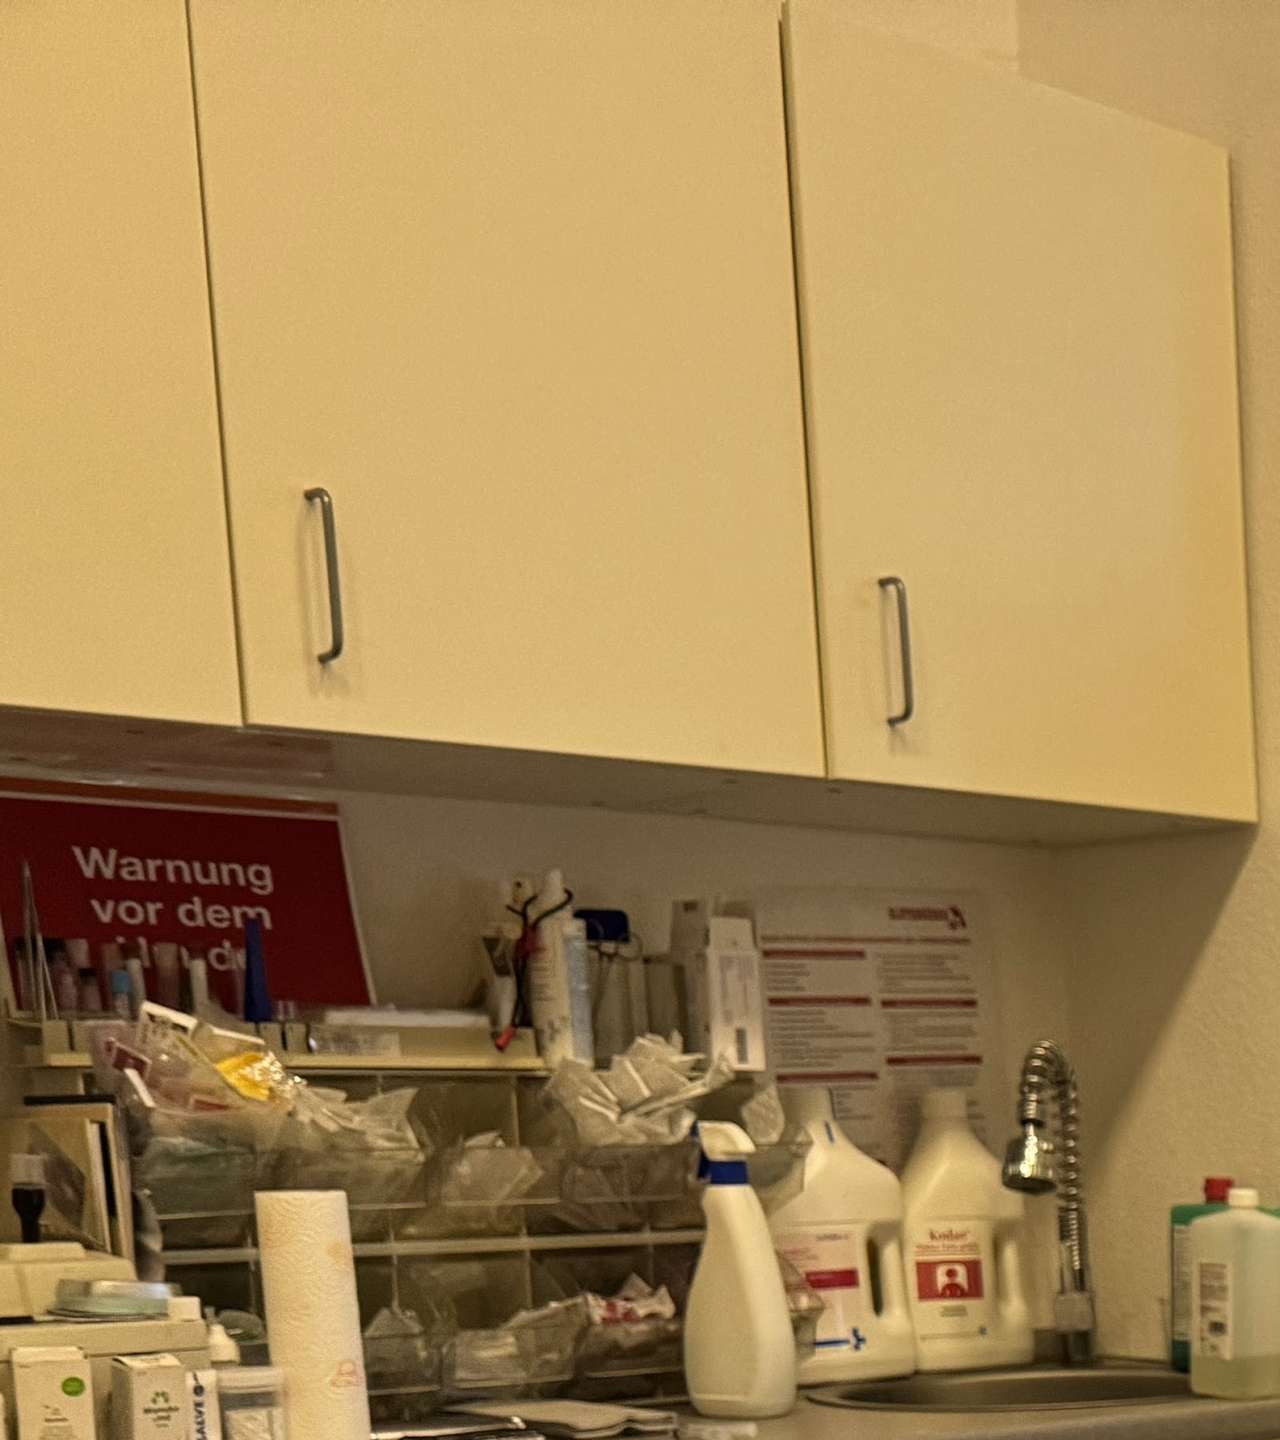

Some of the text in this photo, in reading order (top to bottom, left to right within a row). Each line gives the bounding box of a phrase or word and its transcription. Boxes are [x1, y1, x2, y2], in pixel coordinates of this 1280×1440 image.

[71, 845, 274, 896] Warnung
[90, 896, 272, 930] vor dem
